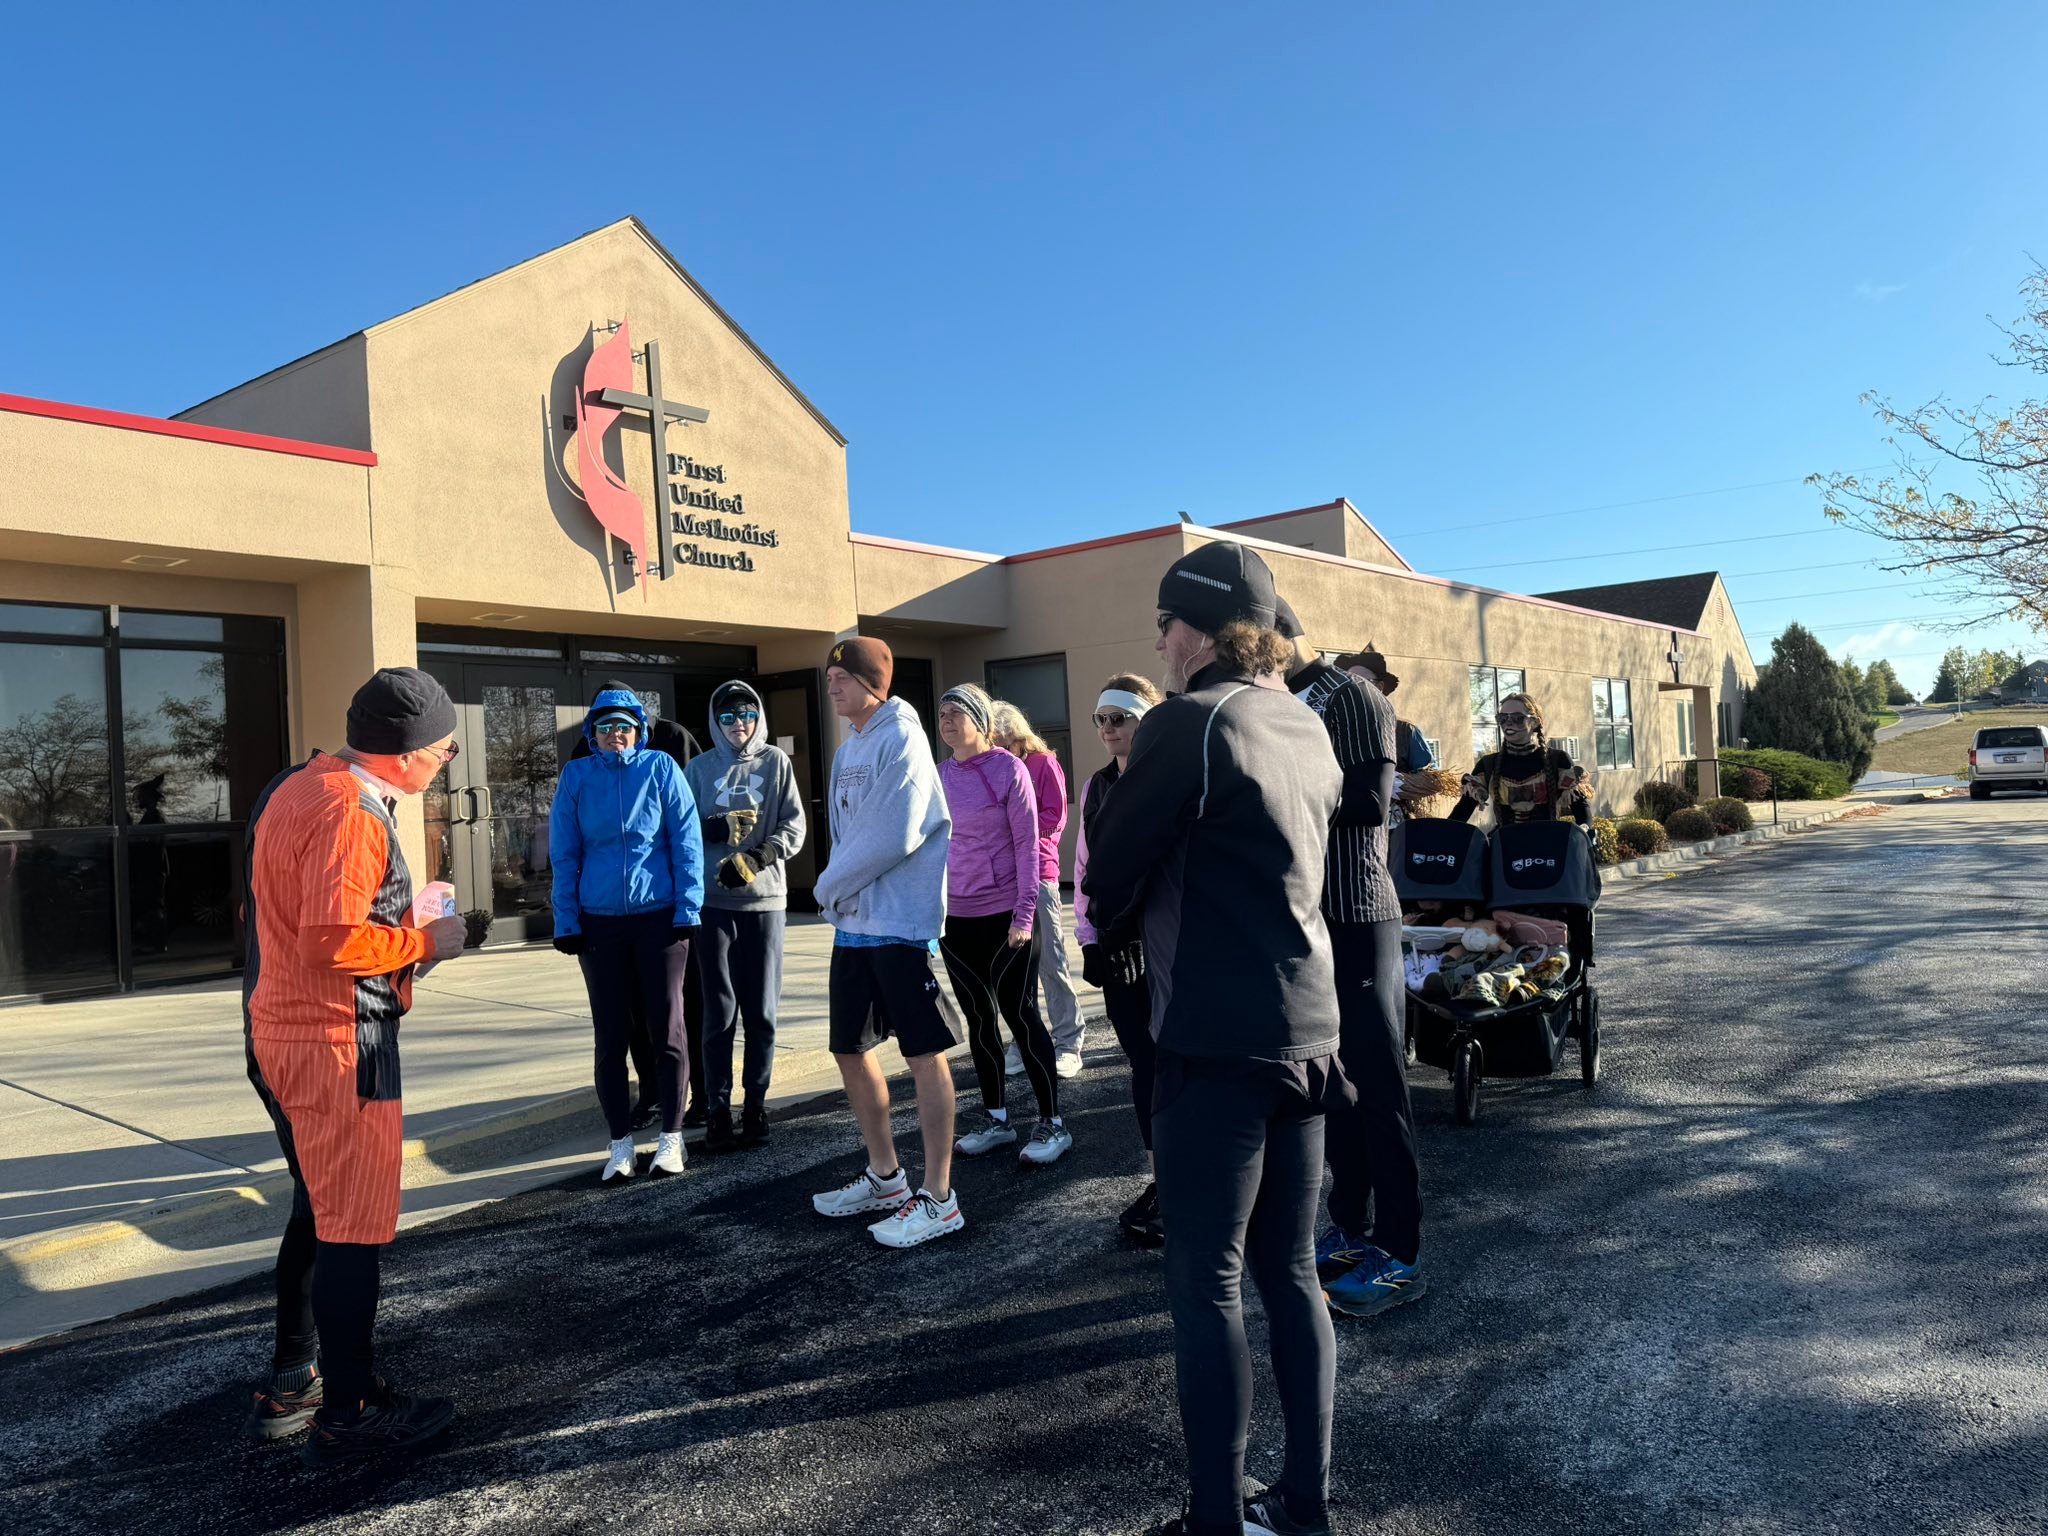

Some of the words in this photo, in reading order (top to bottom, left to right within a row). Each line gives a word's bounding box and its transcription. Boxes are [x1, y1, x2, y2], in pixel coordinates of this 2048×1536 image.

[669, 453, 726, 483] First
[670, 483, 745, 514] United
[672, 512, 779, 548] Methodist
[673, 543, 755, 572] Church
